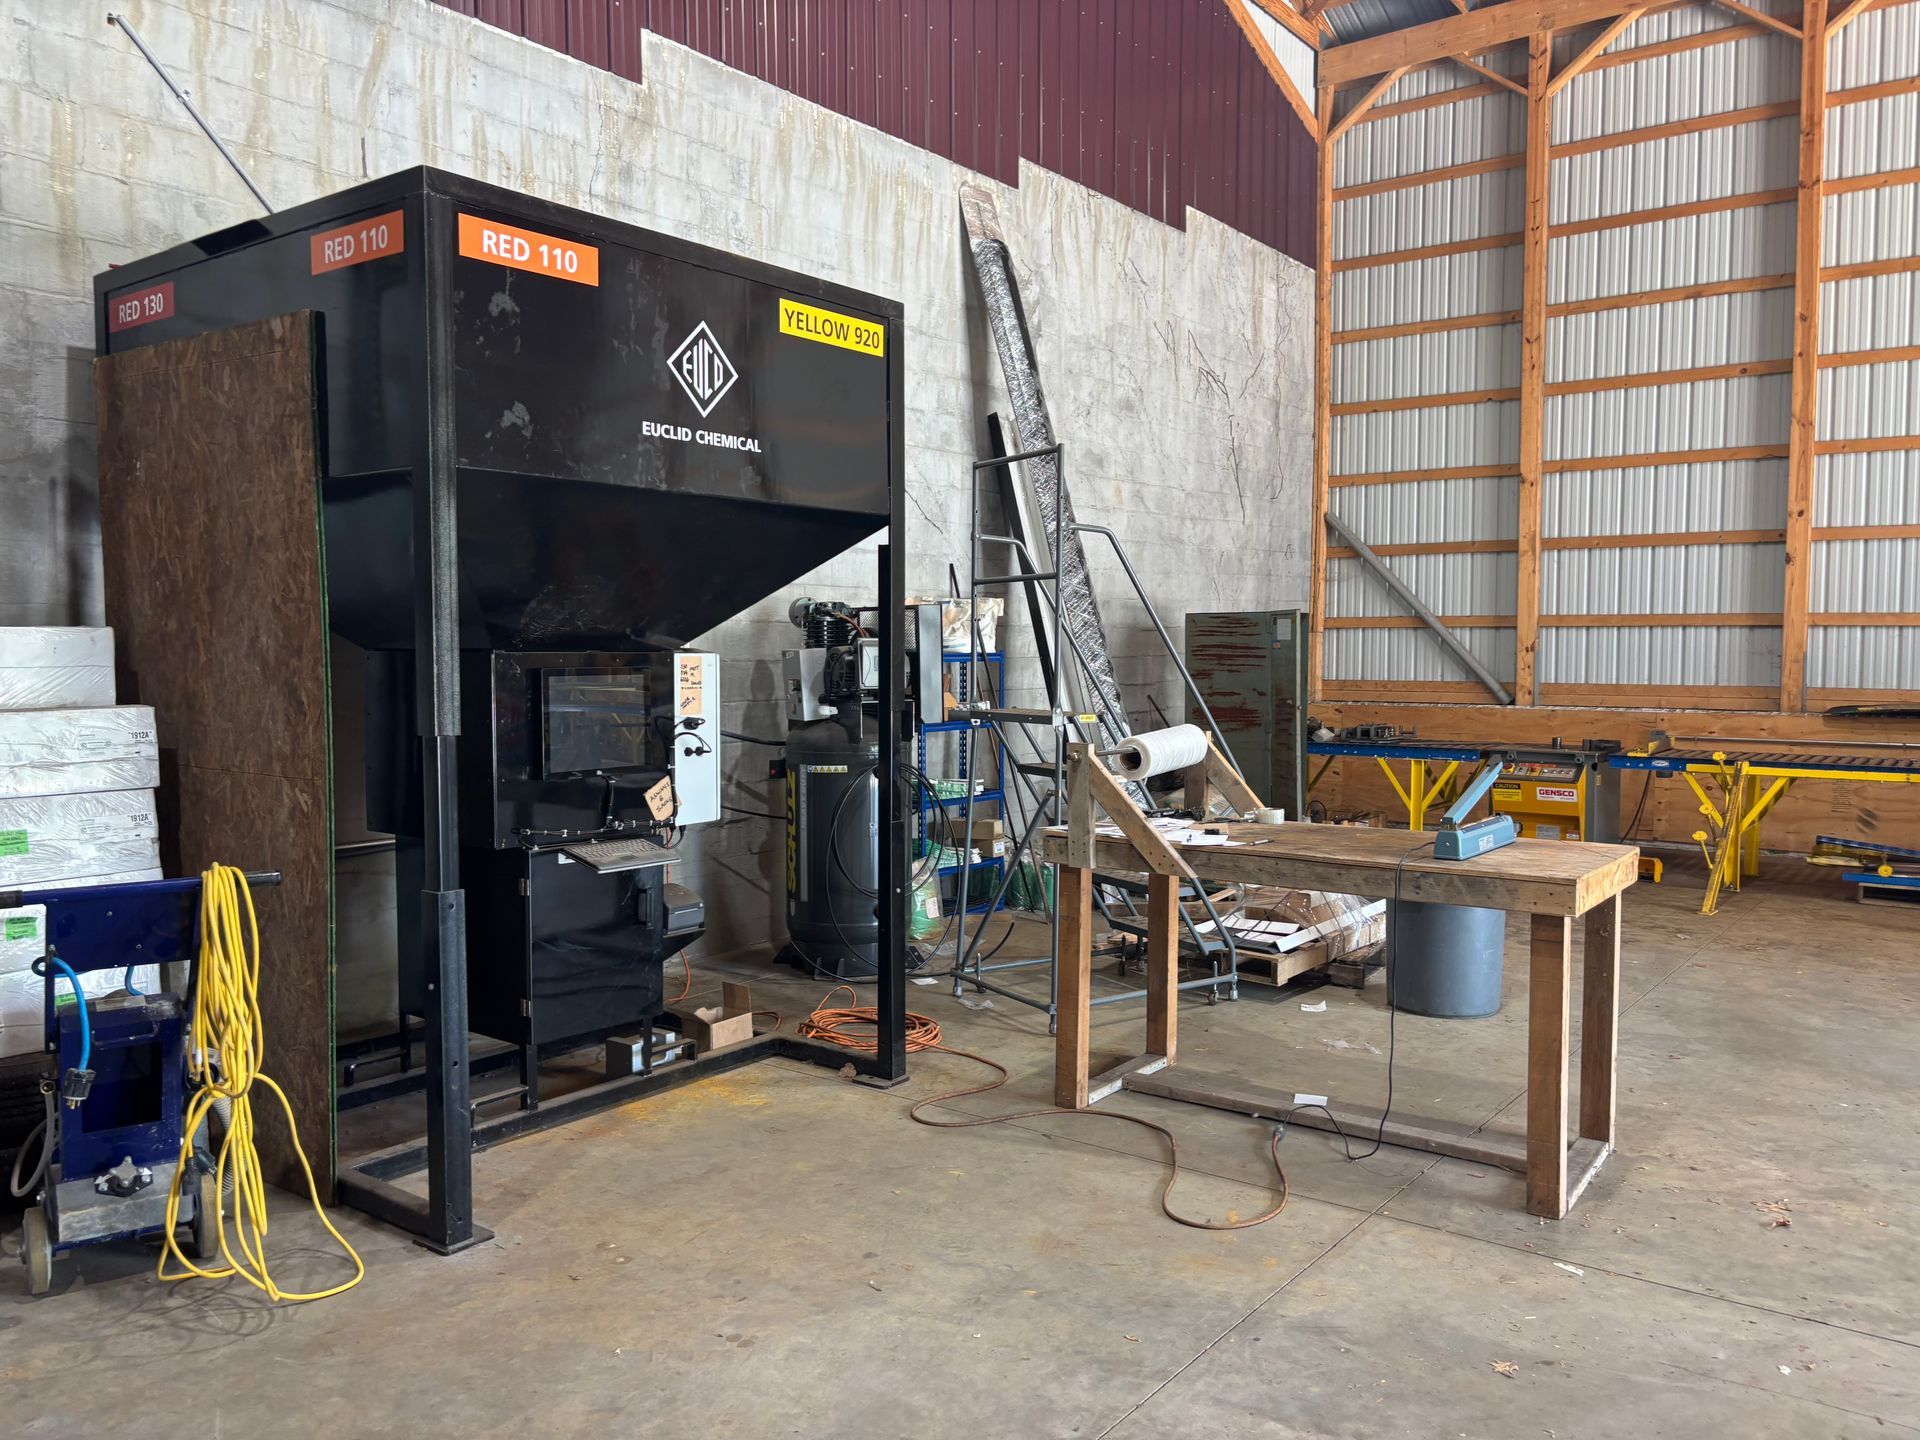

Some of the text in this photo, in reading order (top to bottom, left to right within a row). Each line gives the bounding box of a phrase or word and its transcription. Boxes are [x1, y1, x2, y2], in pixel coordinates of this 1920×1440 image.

[323, 224, 389, 264] RED 110
[481, 229, 579, 274] RED 110
[118, 293, 164, 324] RED 130
[784, 307, 881, 350] YELLOW 920
[642, 420, 762, 454] EUCLID CHEMICAL
[1538, 788, 1575, 797] GENSCO
[786, 768, 797, 894] SCHULZ
